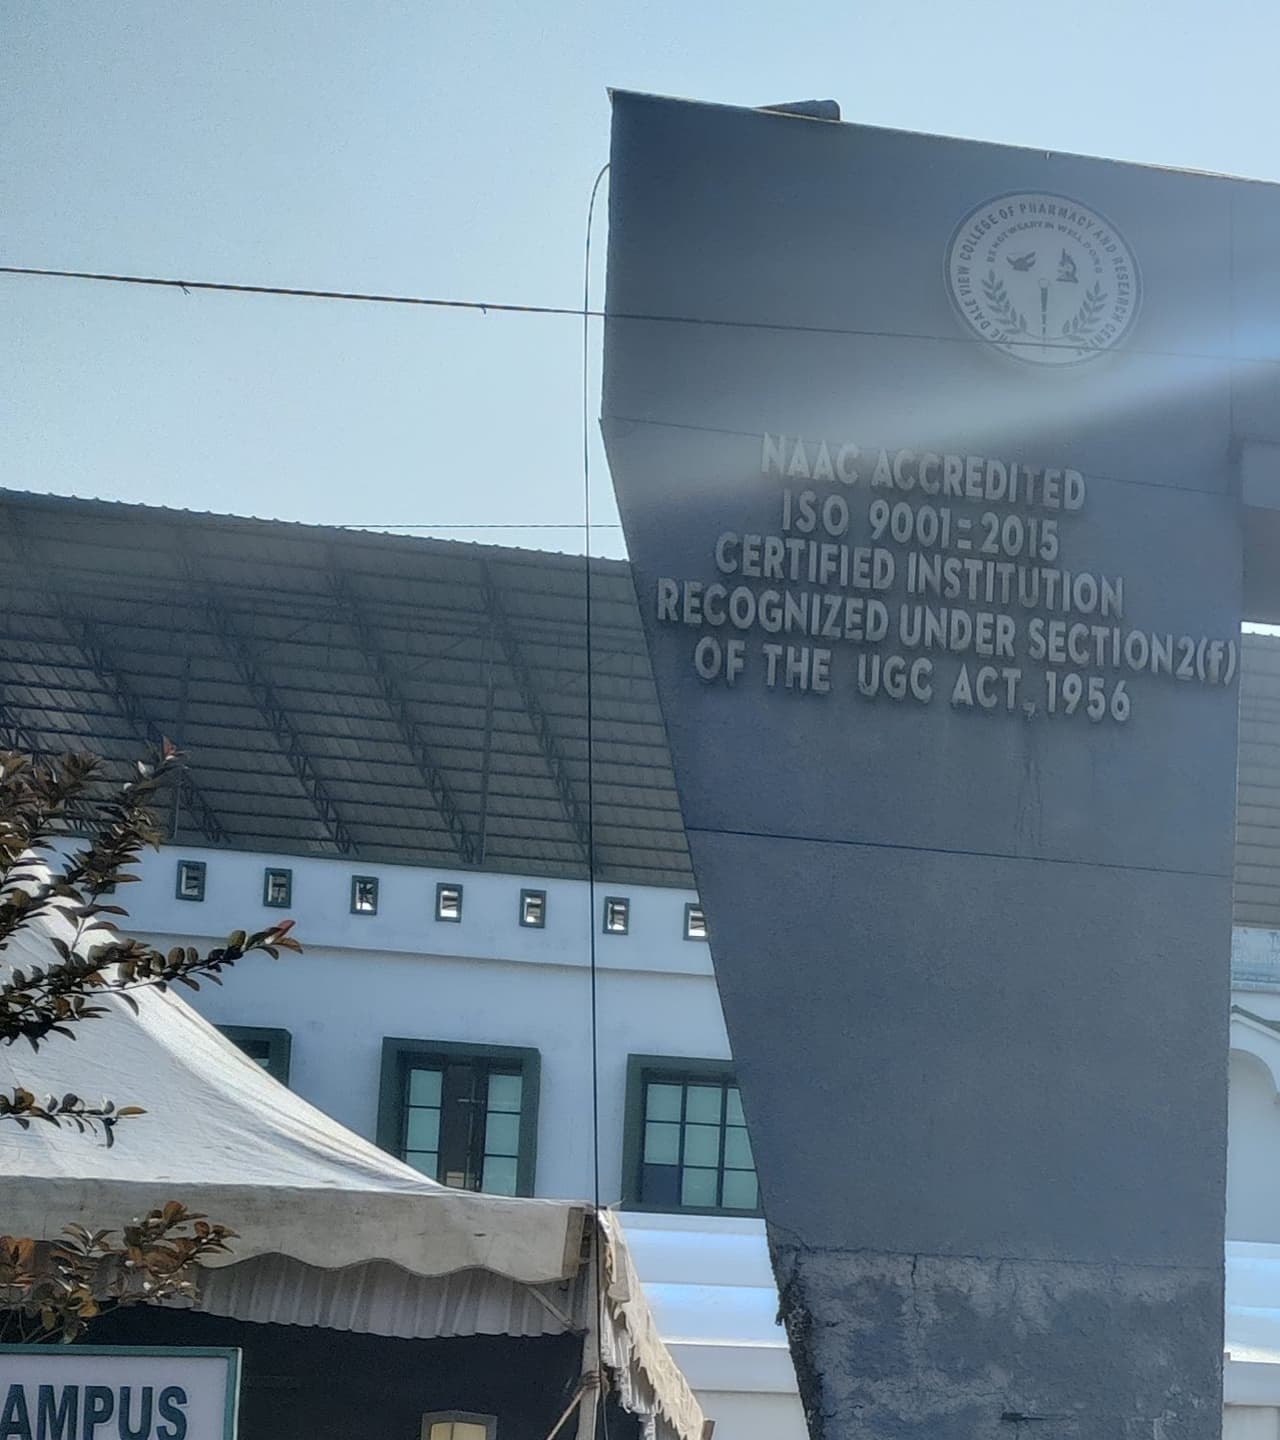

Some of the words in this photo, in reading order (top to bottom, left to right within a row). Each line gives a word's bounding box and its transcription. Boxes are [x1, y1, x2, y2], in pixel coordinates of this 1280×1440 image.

[959, 212, 1000, 262] COLLEGE
[999, 204, 1016, 221] OF
[1018, 202, 1096, 231] PHARMACY
[1091, 230, 1119, 254] AND
[957, 264, 972, 298] VIEW
[1111, 255, 1132, 322] RESEARCH
[759, 431, 860, 486] NAAC
[871, 452, 1086, 513] ACCREDITED
[782, 488, 850, 537] ISO
[714, 530, 895, 592] CERTIFIED
[906, 549, 1125, 619] INSTITUTION
[655, 575, 891, 644] RECOGNIZED
[898, 605, 1017, 659] UNDER
[693, 634, 746, 685] OF
[761, 644, 833, 695] THE
[857, 654, 934, 702] UGC
[1043, 667, 1134, 724] 1956
